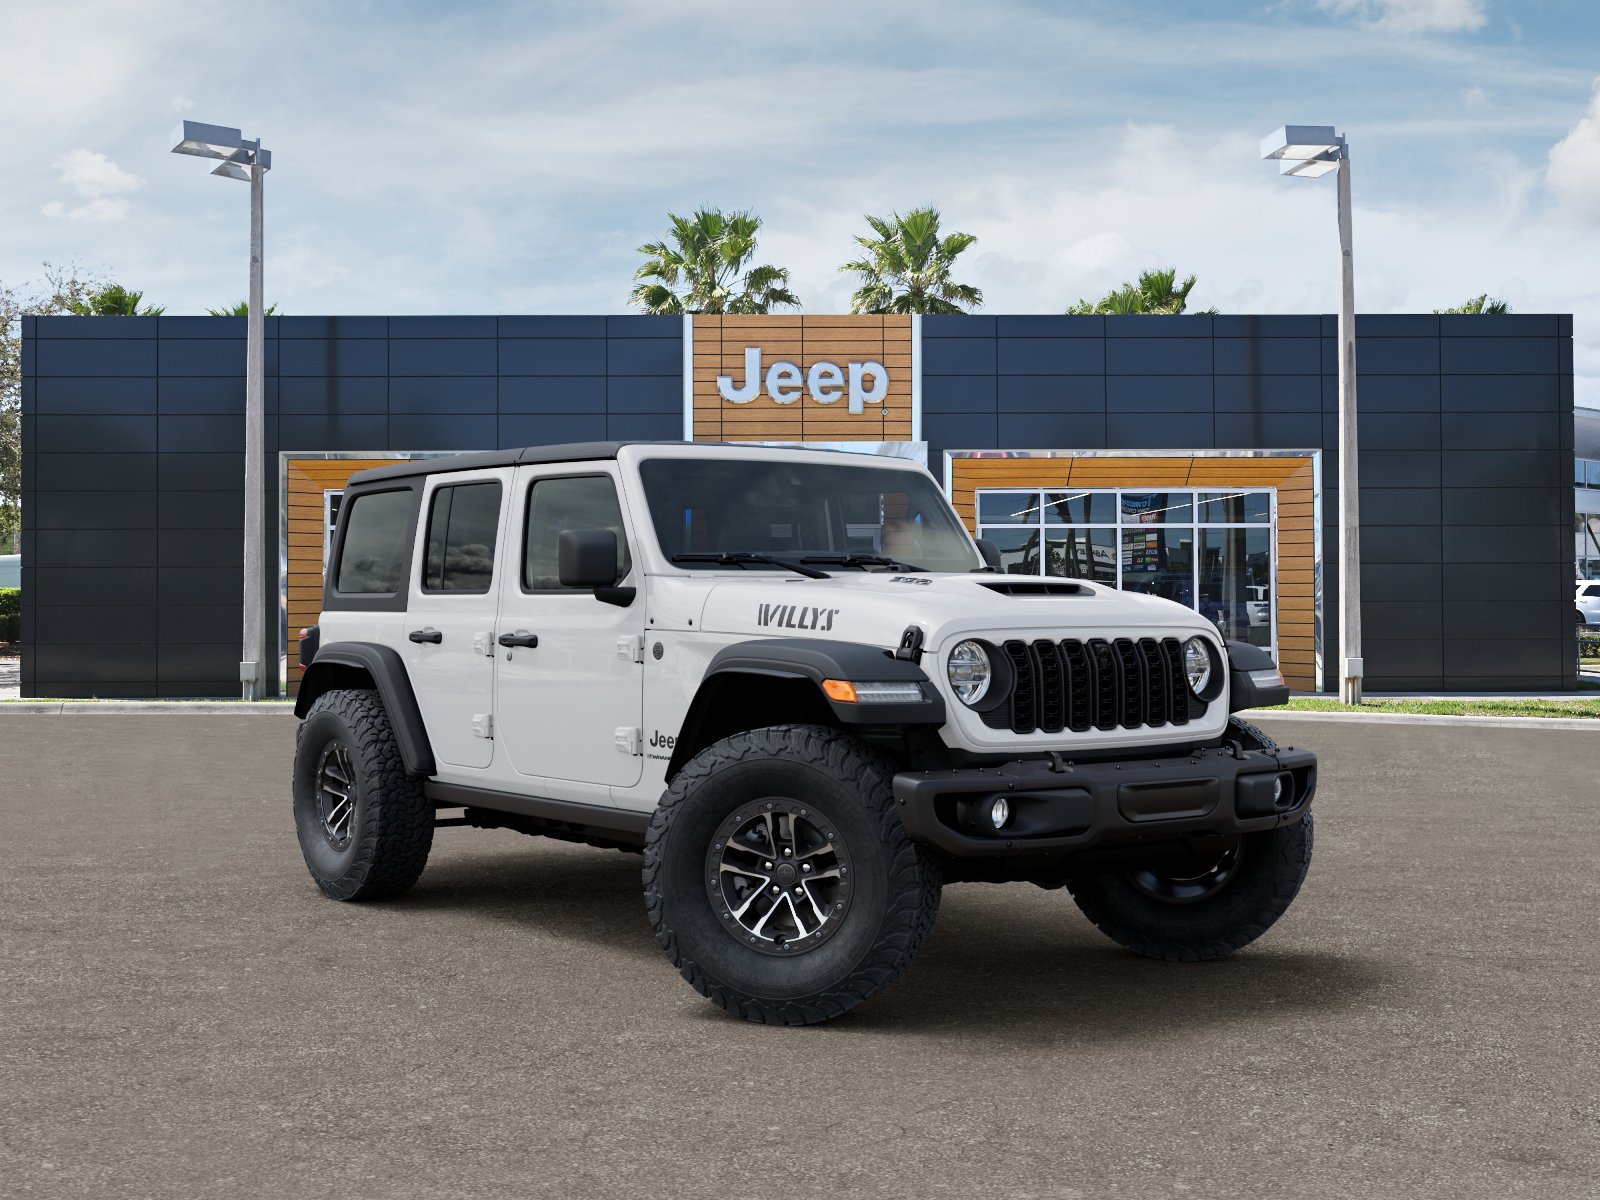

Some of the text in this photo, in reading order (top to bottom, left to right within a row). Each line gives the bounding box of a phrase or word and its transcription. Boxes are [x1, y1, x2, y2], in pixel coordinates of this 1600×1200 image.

[716, 347, 889, 415] Jeep
[757, 603, 840, 632] WILLYS
[649, 729, 679, 749] Jee
